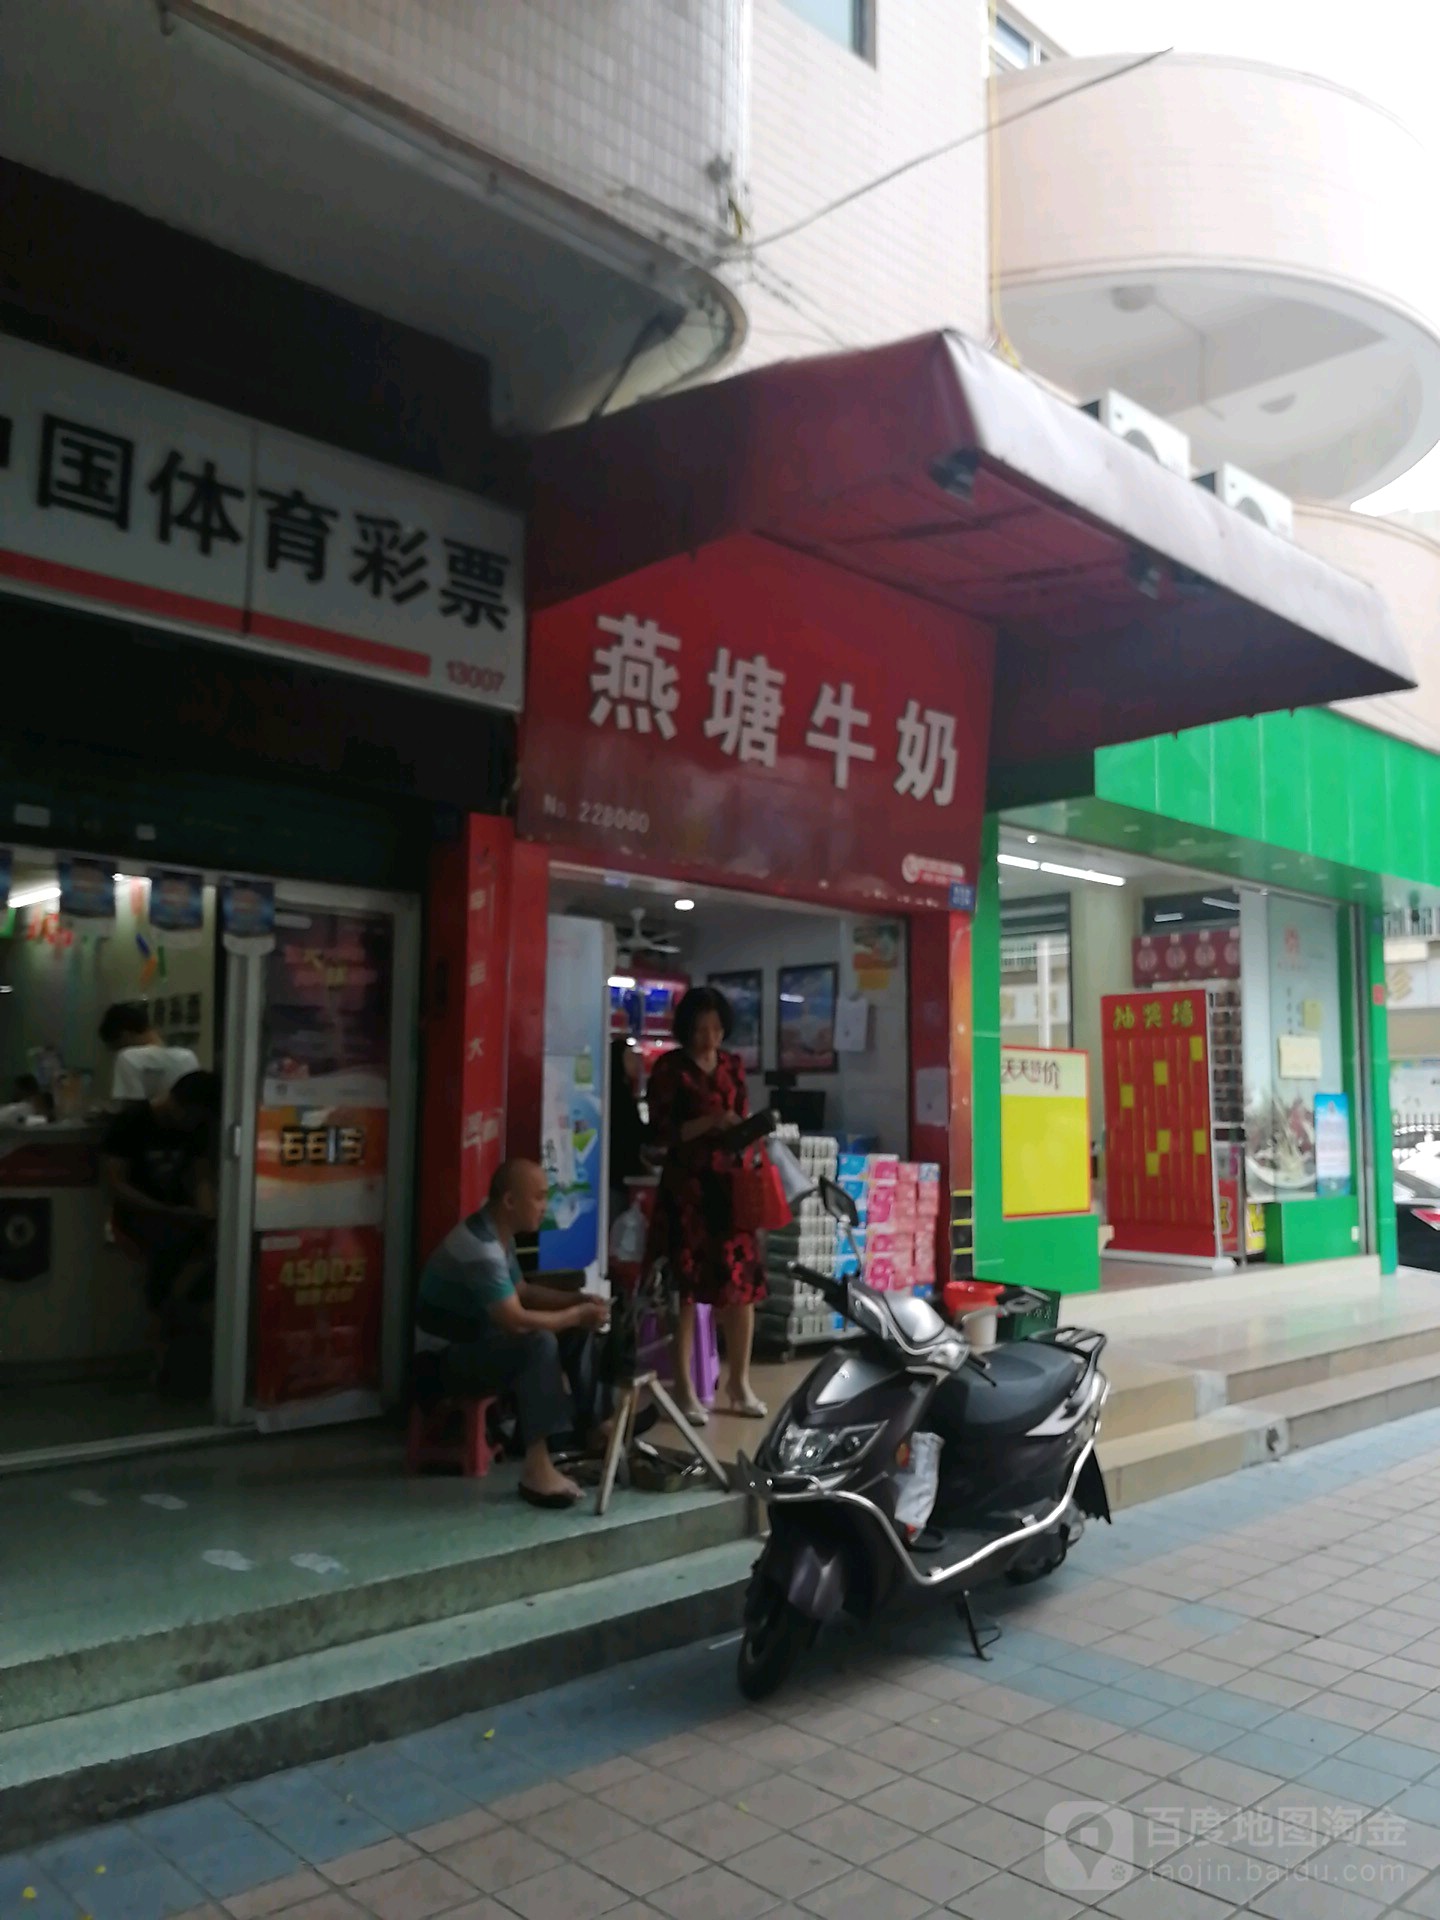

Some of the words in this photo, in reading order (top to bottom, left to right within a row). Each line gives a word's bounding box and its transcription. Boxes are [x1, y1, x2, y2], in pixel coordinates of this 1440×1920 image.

[0, 412, 511, 632] 国体育彩票
[590, 613, 959, 807] 燕塘牛奶
